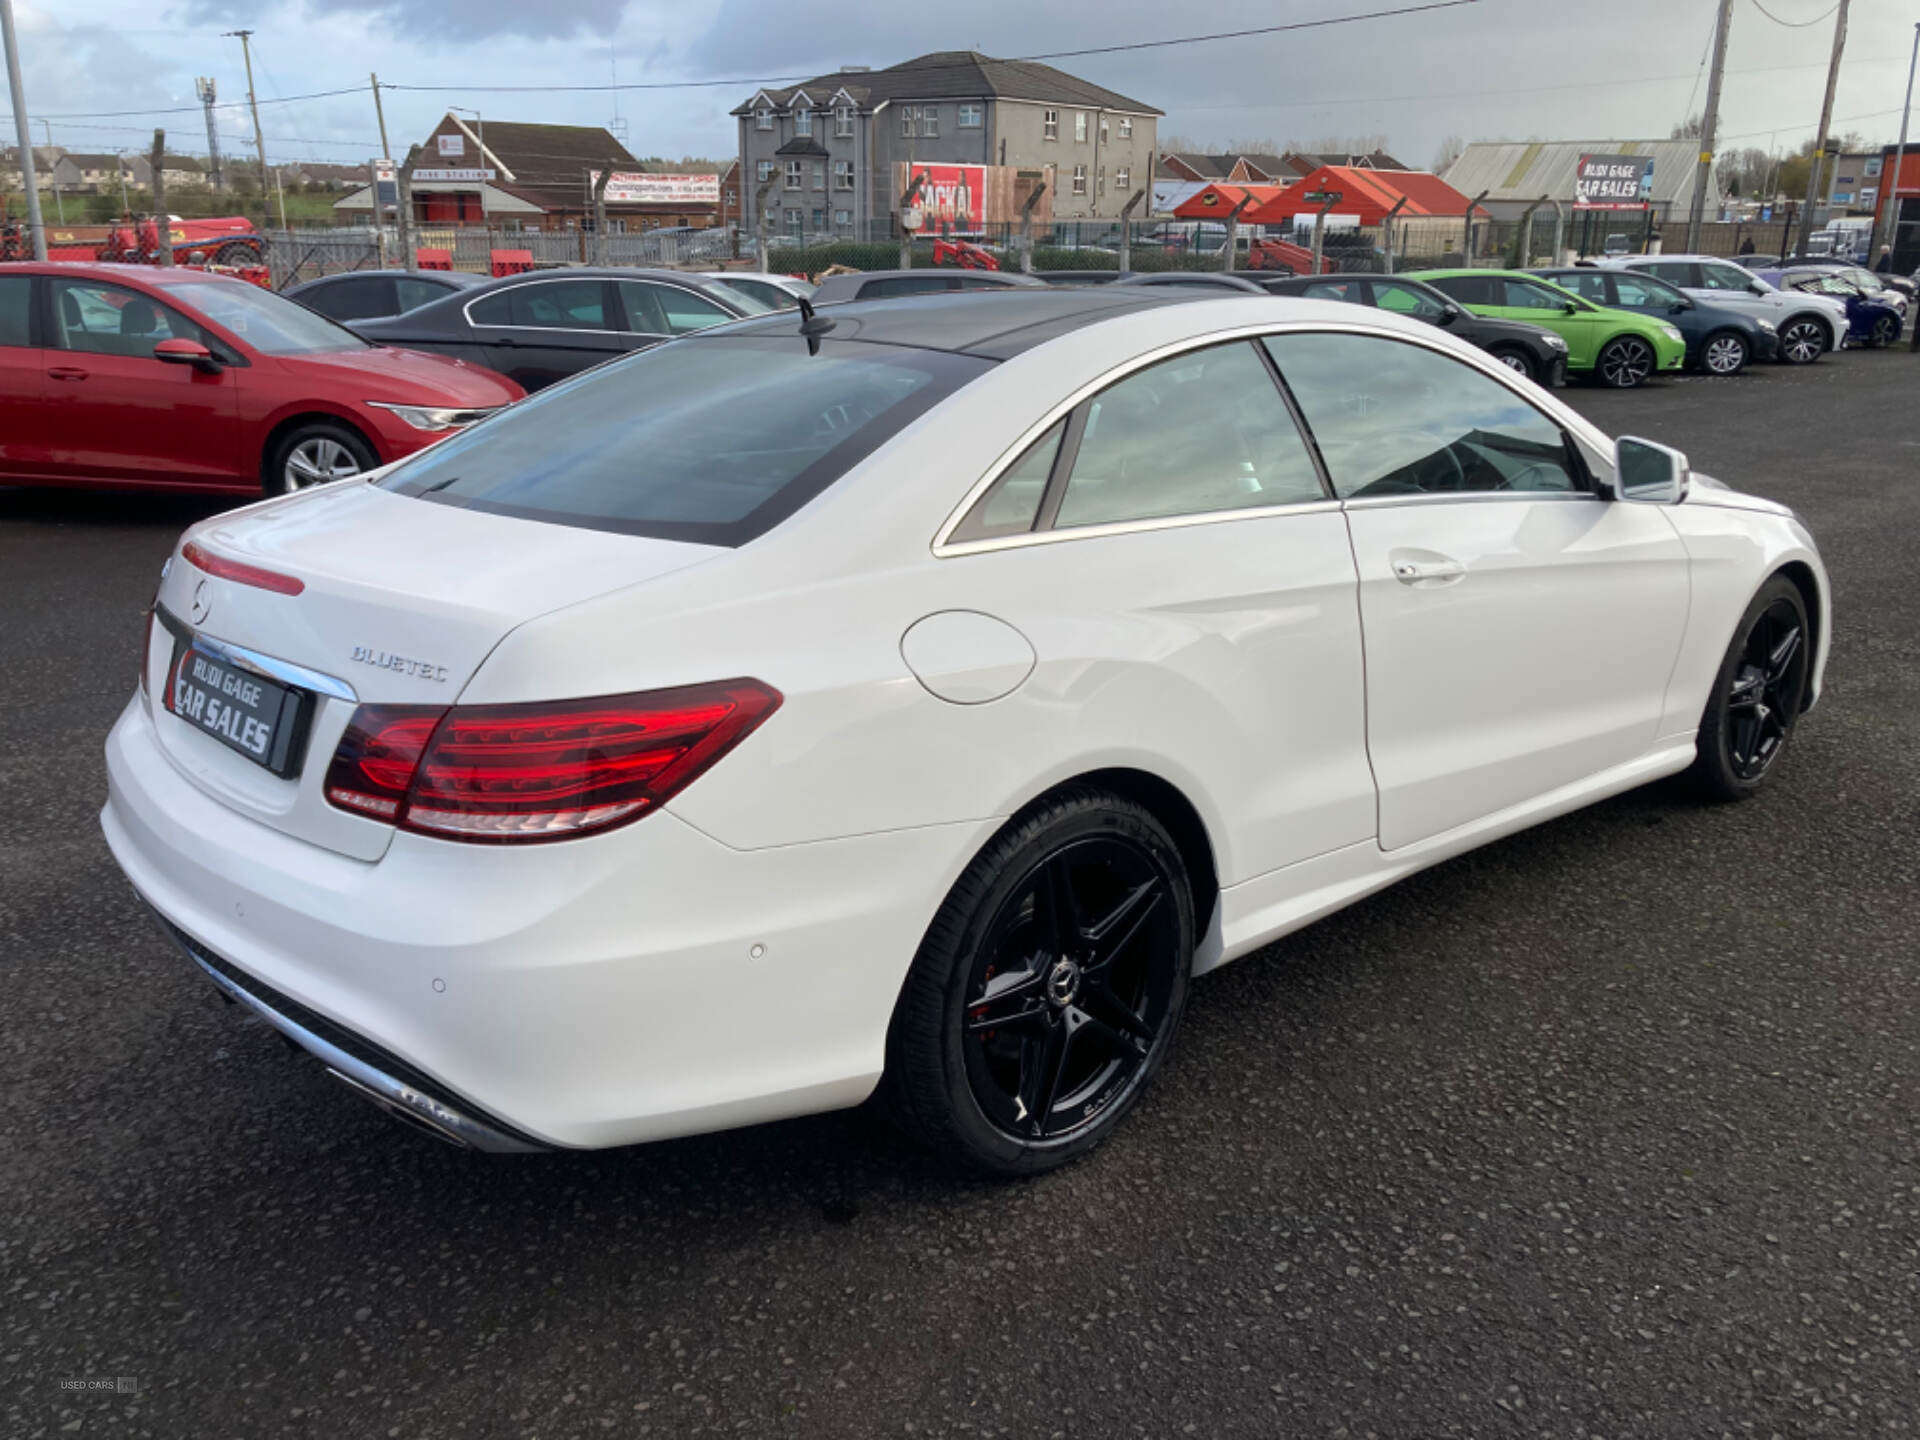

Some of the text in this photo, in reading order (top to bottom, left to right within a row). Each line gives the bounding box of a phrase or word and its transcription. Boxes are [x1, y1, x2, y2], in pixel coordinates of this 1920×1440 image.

[1584, 164, 1636, 178] RUDI GAGE
[1576, 180, 1639, 198] CAR SALES
[350, 647, 448, 682] BLUETEC
[192, 657, 262, 708] RUDI GAGE
[174, 679, 270, 754] CAR SALES
